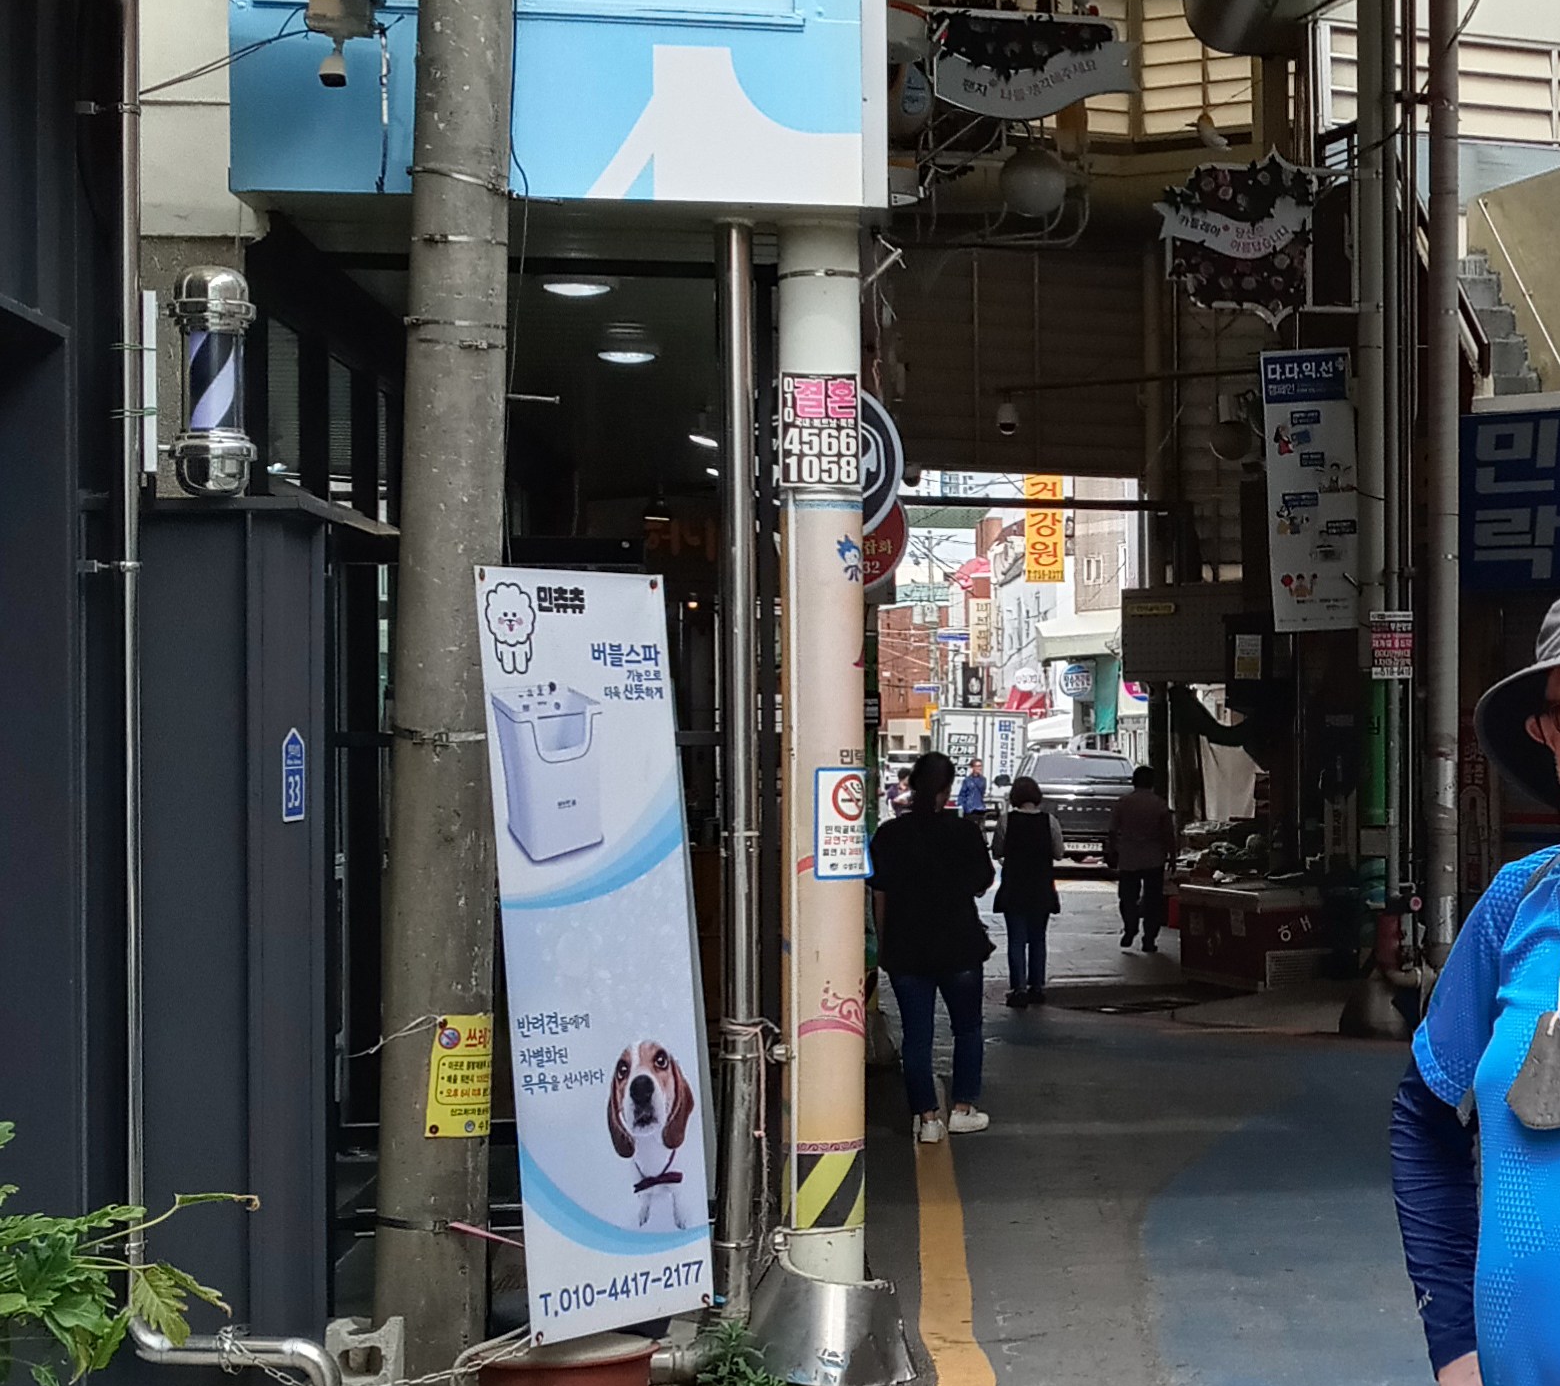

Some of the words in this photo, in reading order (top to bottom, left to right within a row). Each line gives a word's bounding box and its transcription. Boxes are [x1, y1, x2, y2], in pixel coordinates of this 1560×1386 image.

[783, 377, 794, 422] 010
[794, 378, 856, 418] 결혼
[784, 428, 857, 456] 4566
[785, 456, 858, 483] 1058
[591, 642, 661, 667] 버블스파
[623, 683, 664, 701] 산뜻하게
[288, 774, 300, 808] 33
[517, 1012, 590, 1038] 반려견들에게
[520, 1045, 568, 1068] 차별화된
[521, 1072, 560, 1095] 목욕을
[562, 1068, 604, 1089] 선사하다
[539, 1260, 704, 1317] T.010-4417-2177
